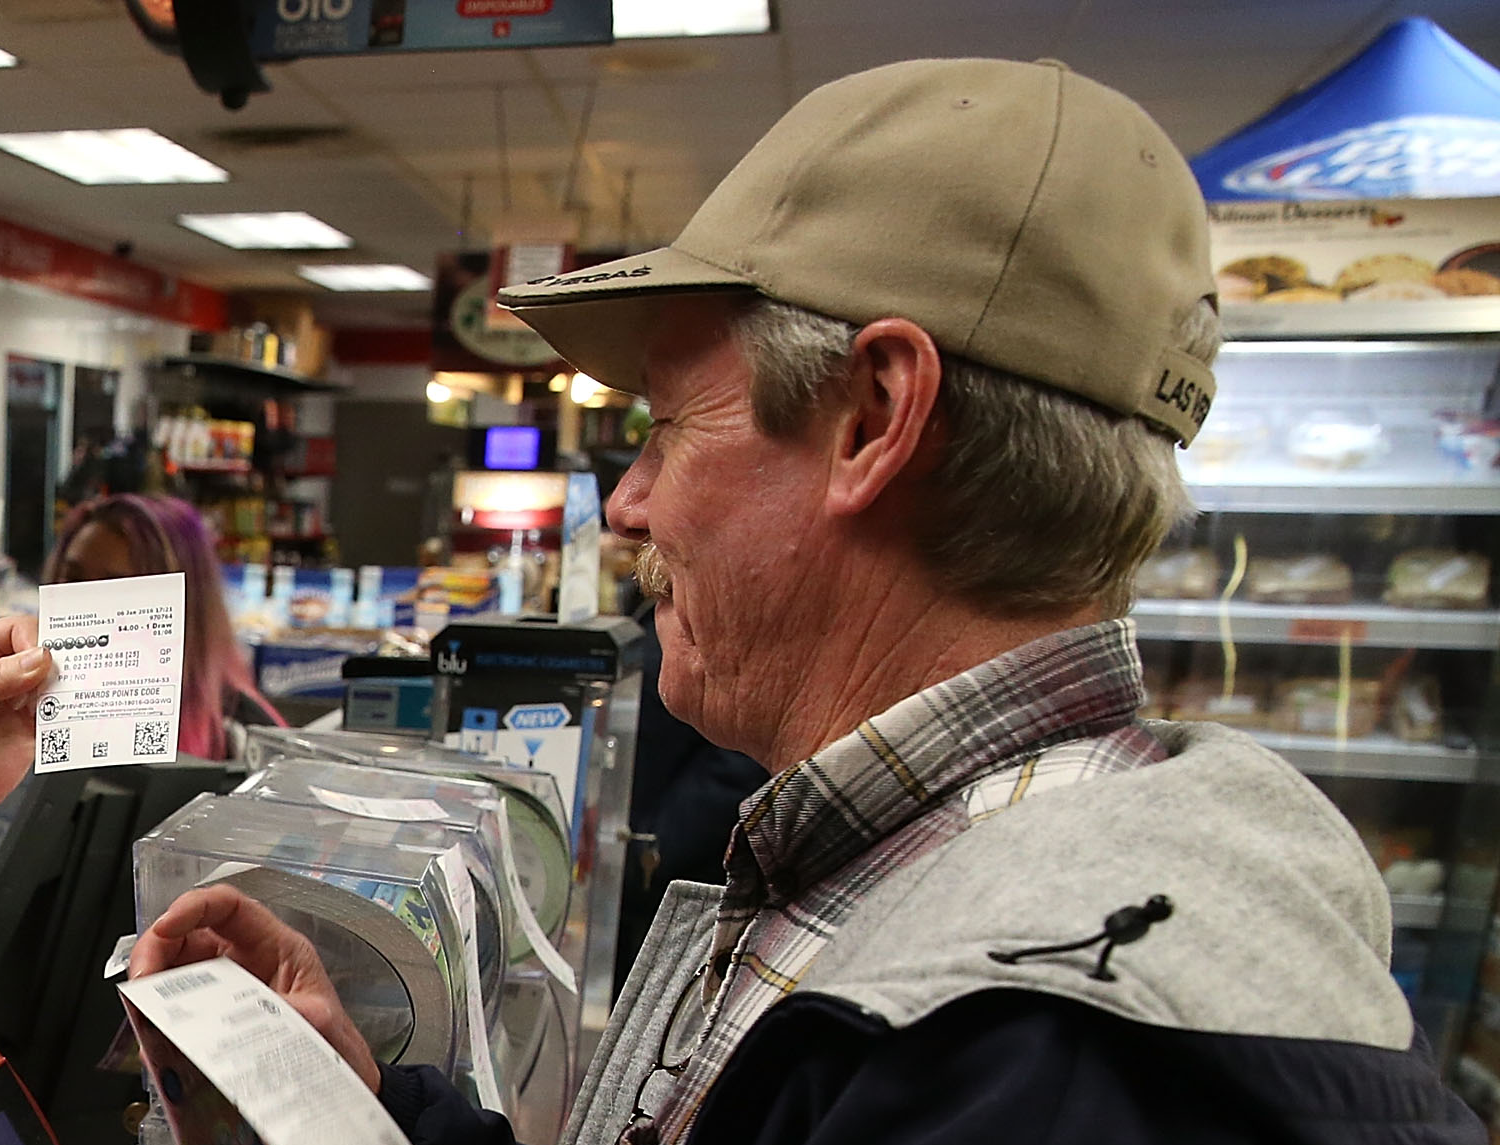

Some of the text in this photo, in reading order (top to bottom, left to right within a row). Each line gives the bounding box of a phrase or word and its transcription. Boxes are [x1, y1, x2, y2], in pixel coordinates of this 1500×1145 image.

[1155, 369, 1195, 412] LAS
[160, 648, 171, 656] QP
[74, 687, 160, 700] REWARDS POINTS CODE
[514, 708, 560, 729] NEW
